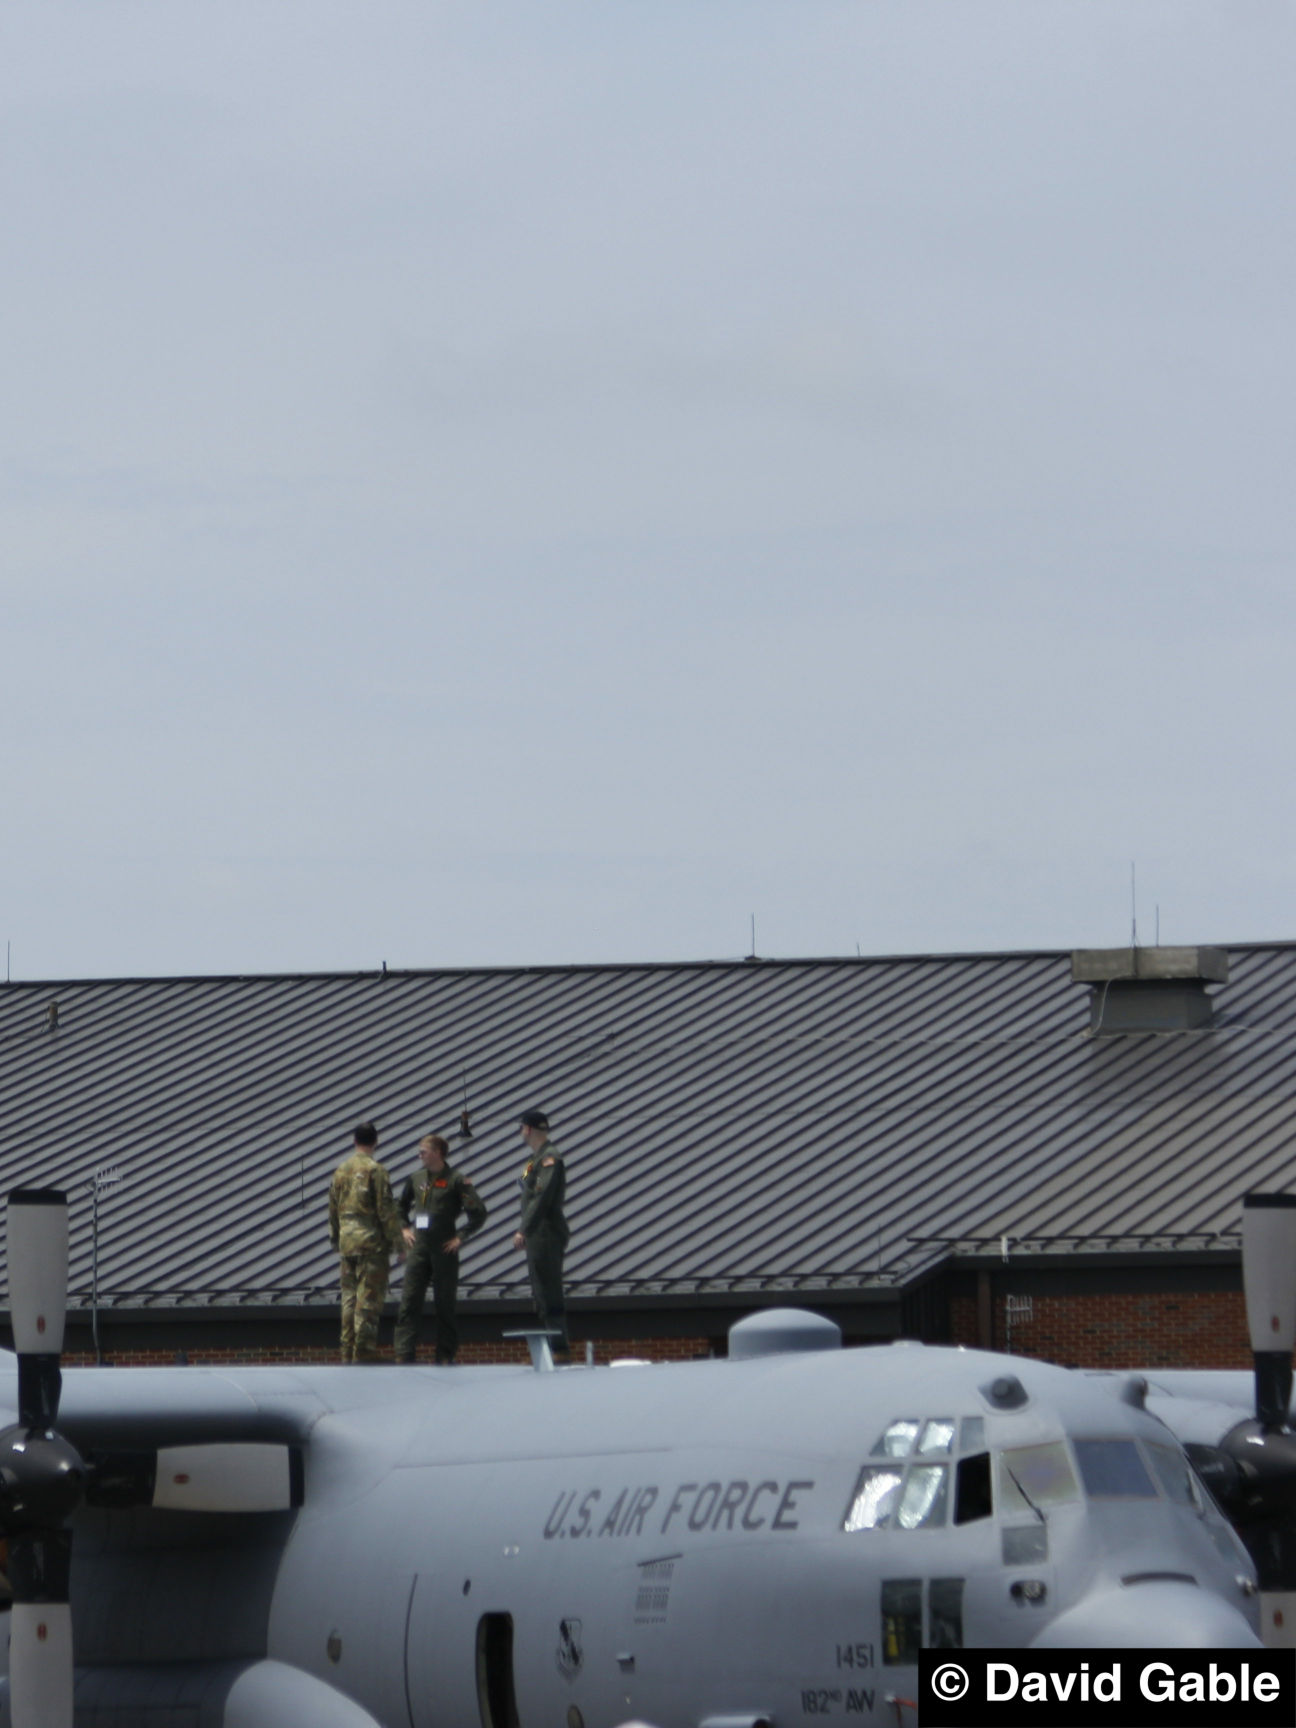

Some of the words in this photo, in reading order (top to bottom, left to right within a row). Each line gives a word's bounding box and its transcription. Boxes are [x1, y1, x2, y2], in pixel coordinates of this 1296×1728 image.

[598, 1486, 659, 1537] AIR
[660, 1481, 815, 1535] FORCE
[835, 1643, 875, 1669] 1451
[845, 1688, 875, 1713] AW
